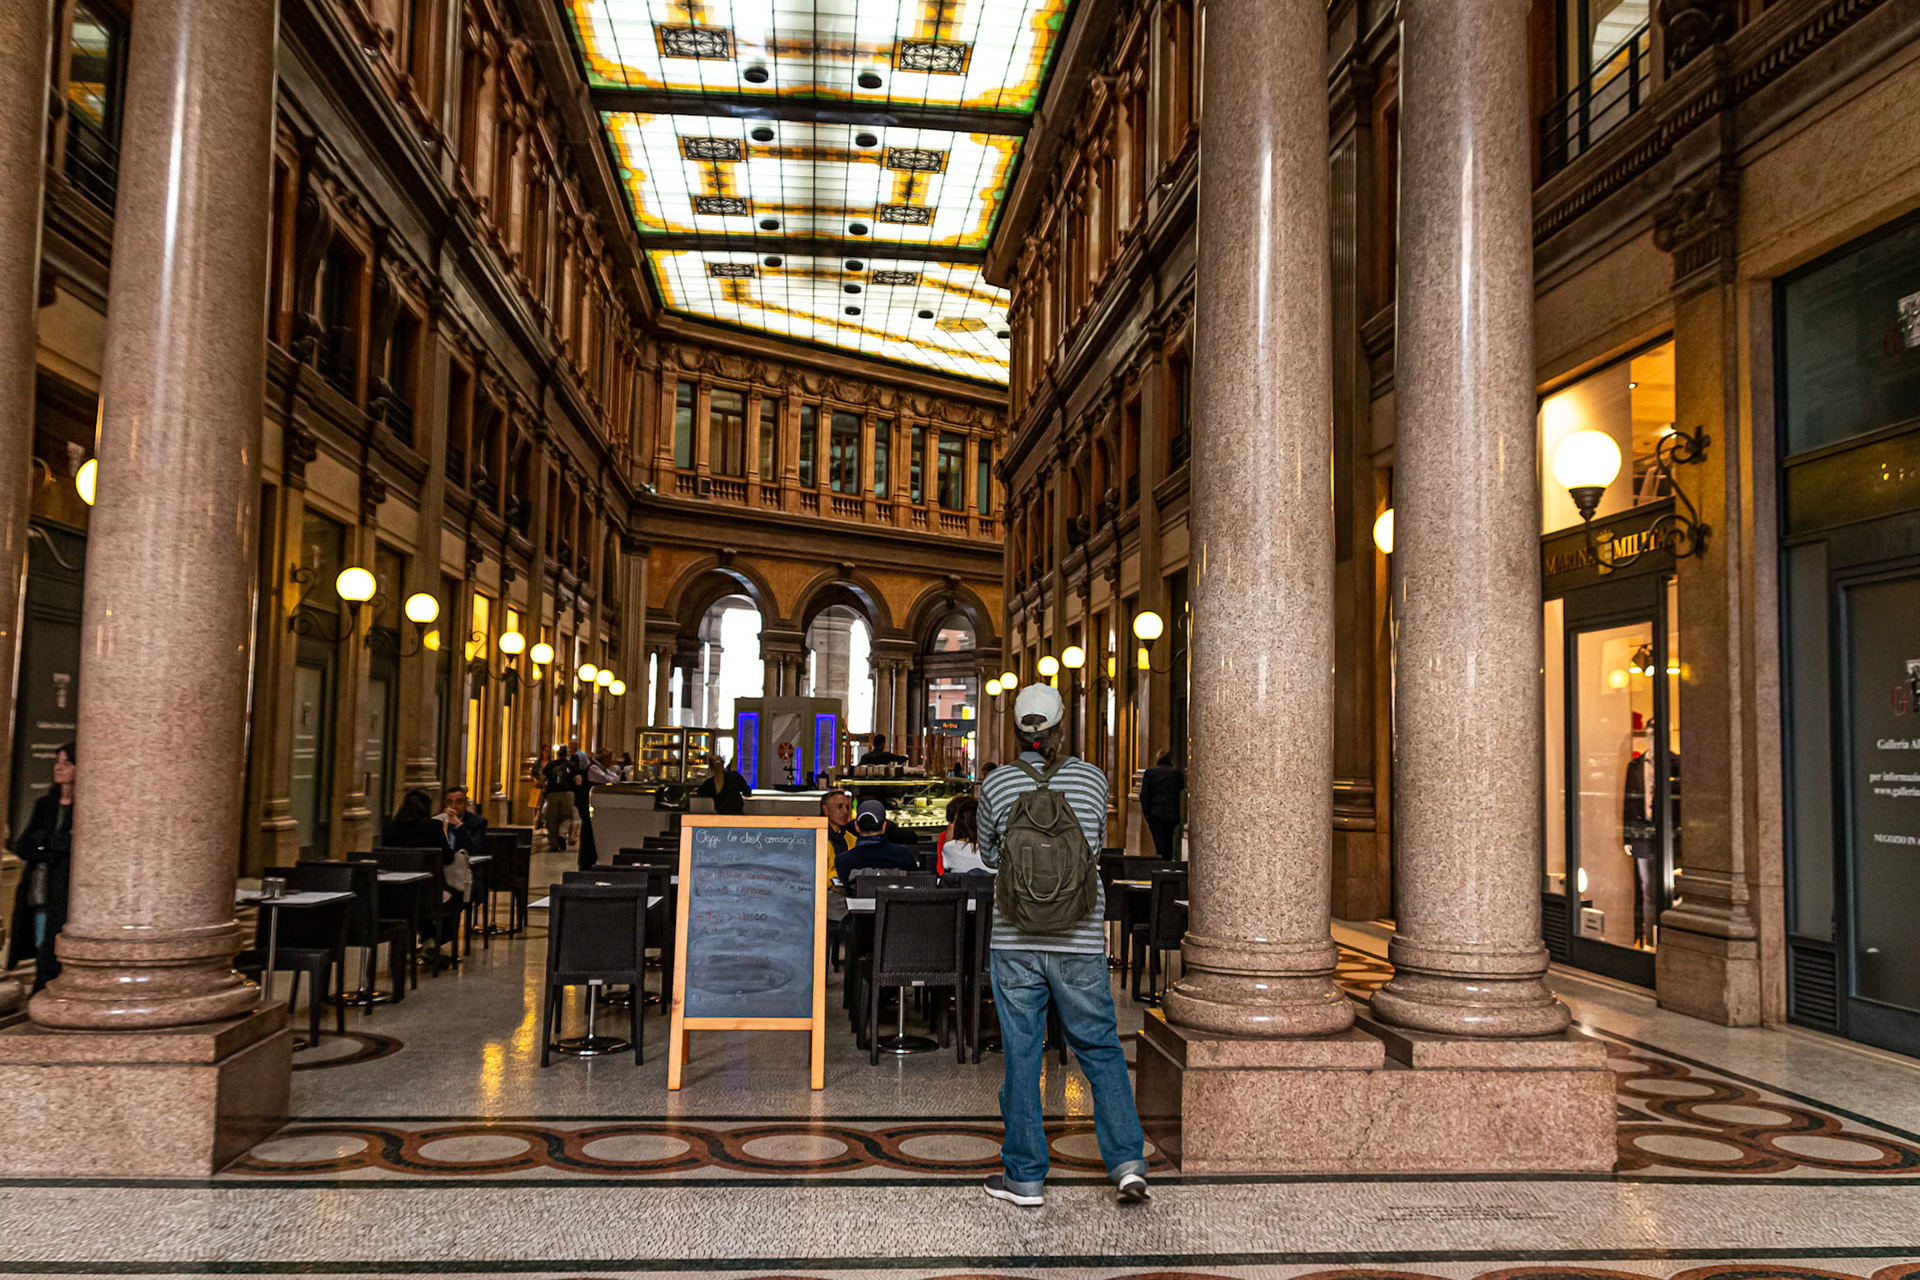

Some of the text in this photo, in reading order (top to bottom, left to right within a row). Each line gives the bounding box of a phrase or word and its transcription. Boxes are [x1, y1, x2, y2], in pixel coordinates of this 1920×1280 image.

[695, 829, 721, 849] Oggi
[727, 830, 738, 842] lo
[740, 831, 763, 849] chef
